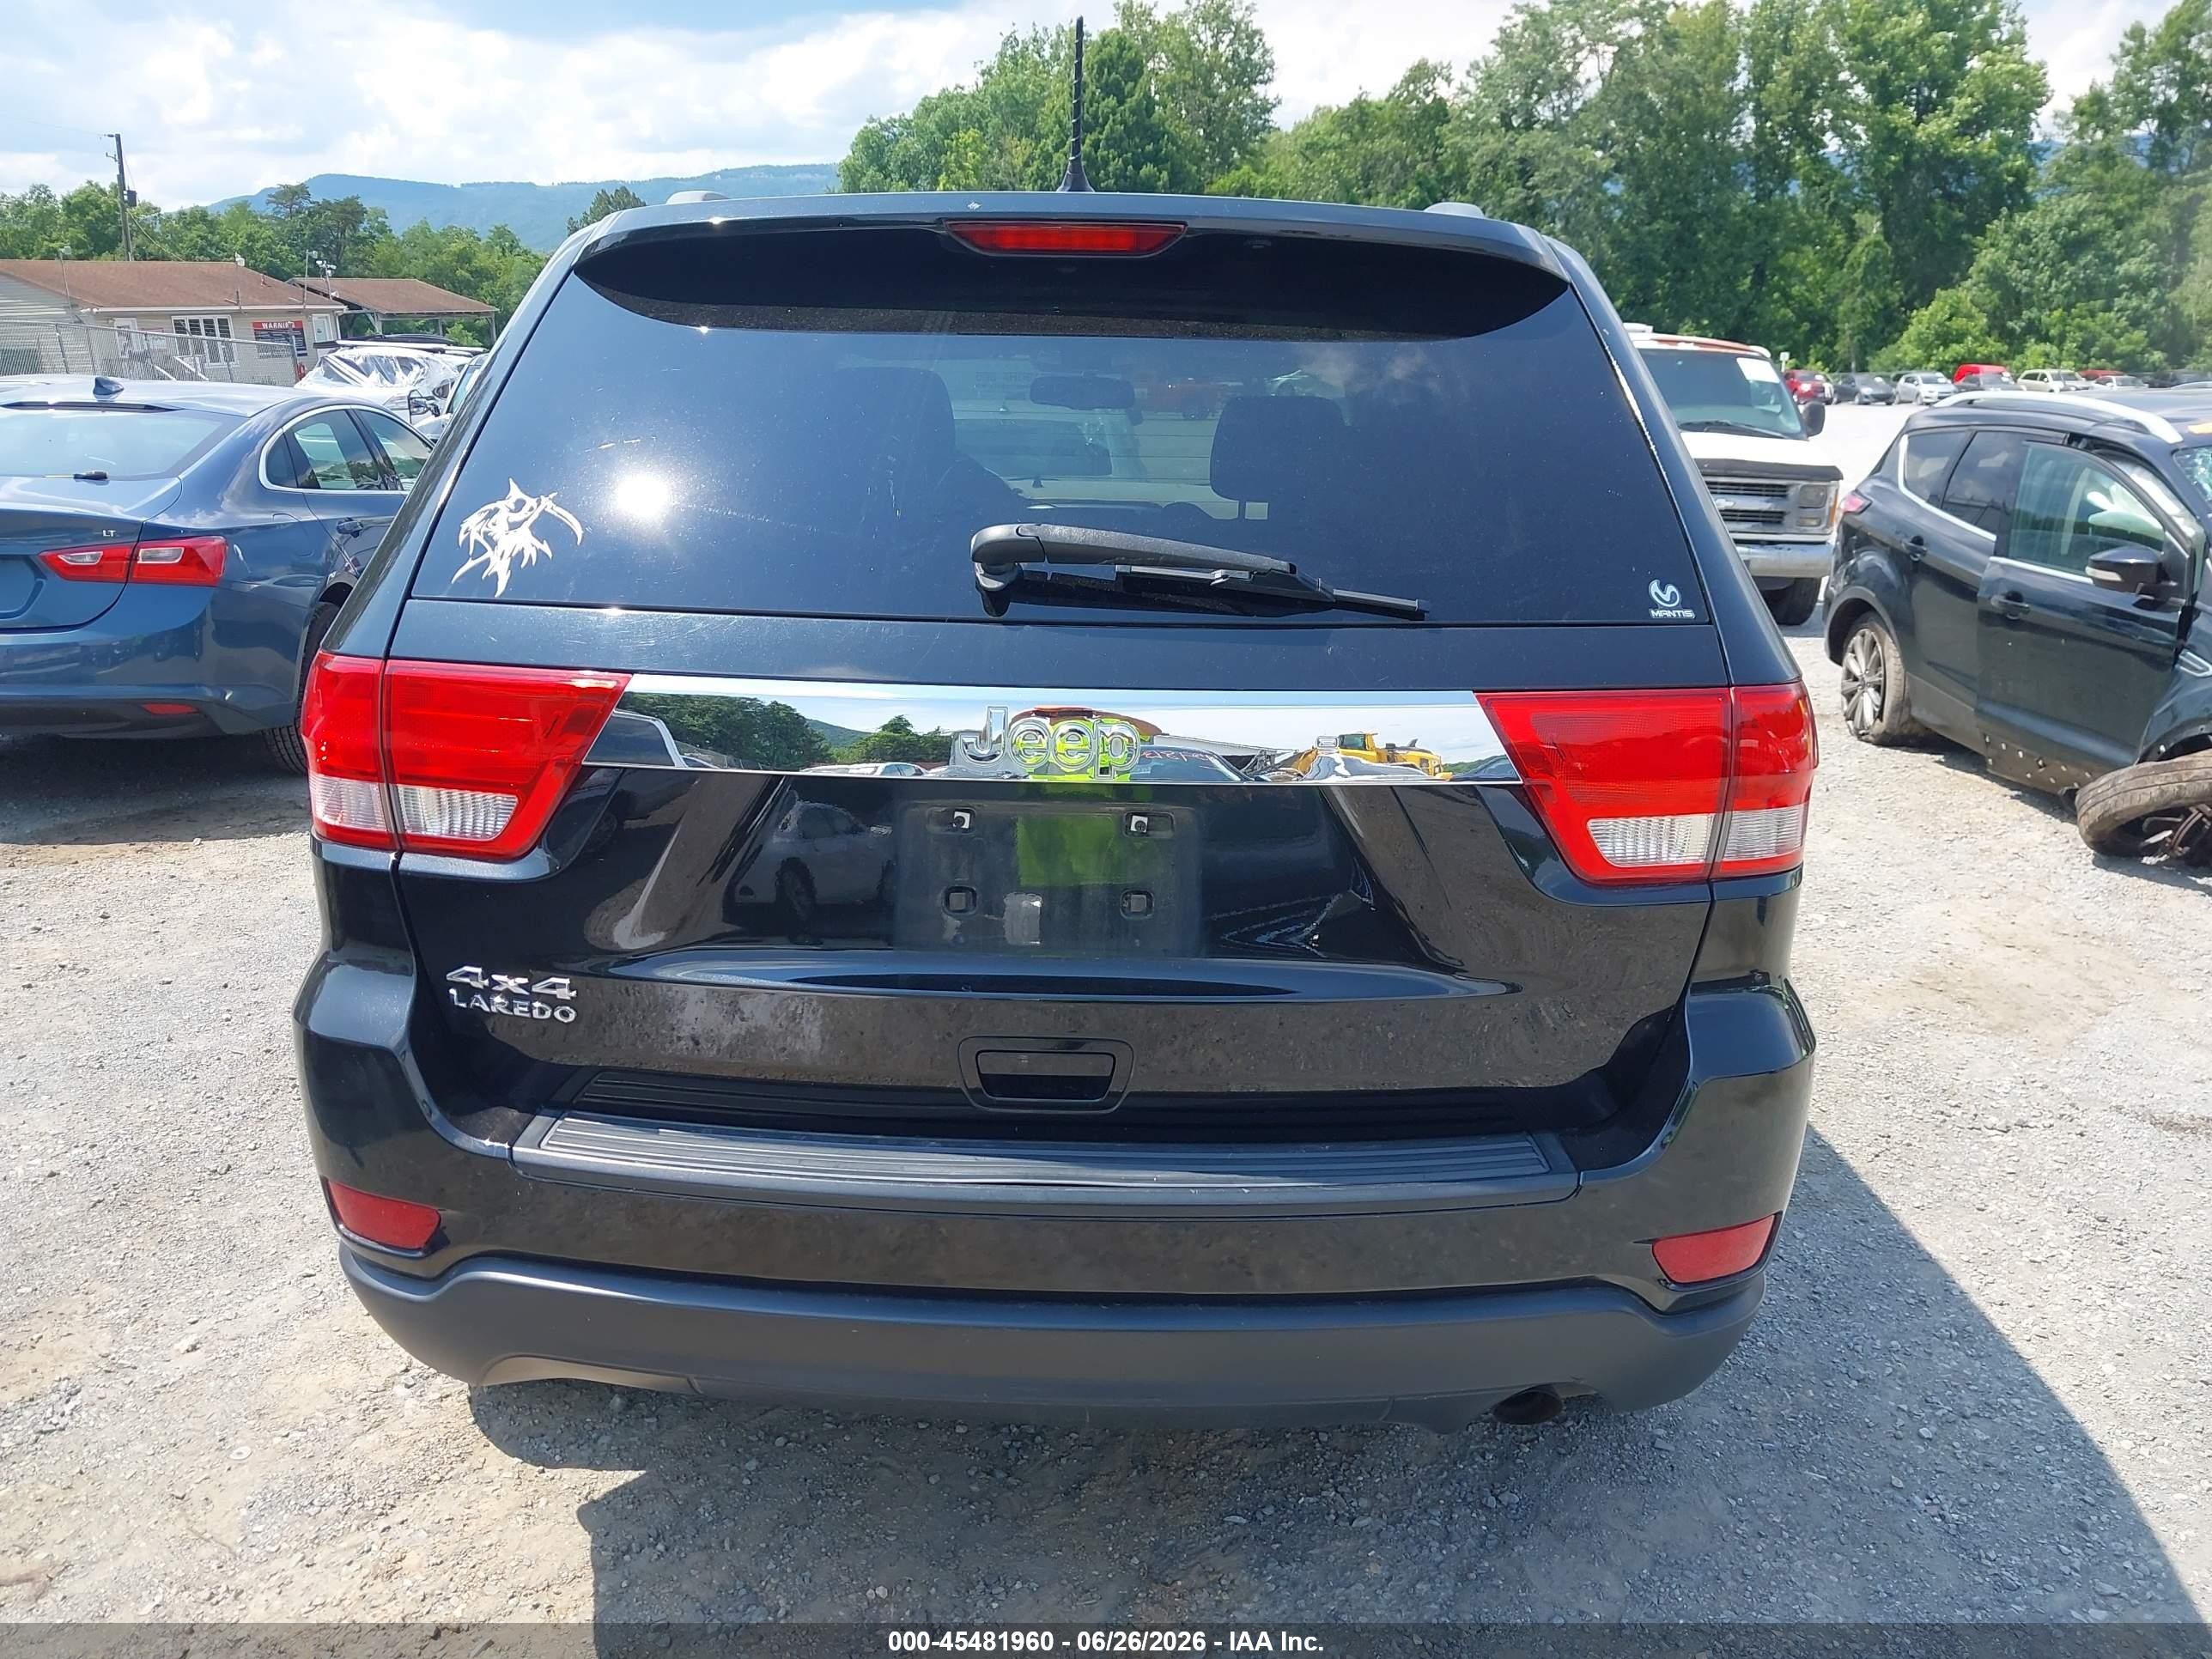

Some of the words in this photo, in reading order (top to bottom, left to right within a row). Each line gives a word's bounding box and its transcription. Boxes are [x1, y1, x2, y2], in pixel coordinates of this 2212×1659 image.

[102, 529, 118, 538] LT
[1650, 609, 1696, 619] MANTIS
[957, 705, 1142, 781] Jeep
[446, 964, 578, 1000] 4x4
[447, 988, 579, 1024] LAREDO
